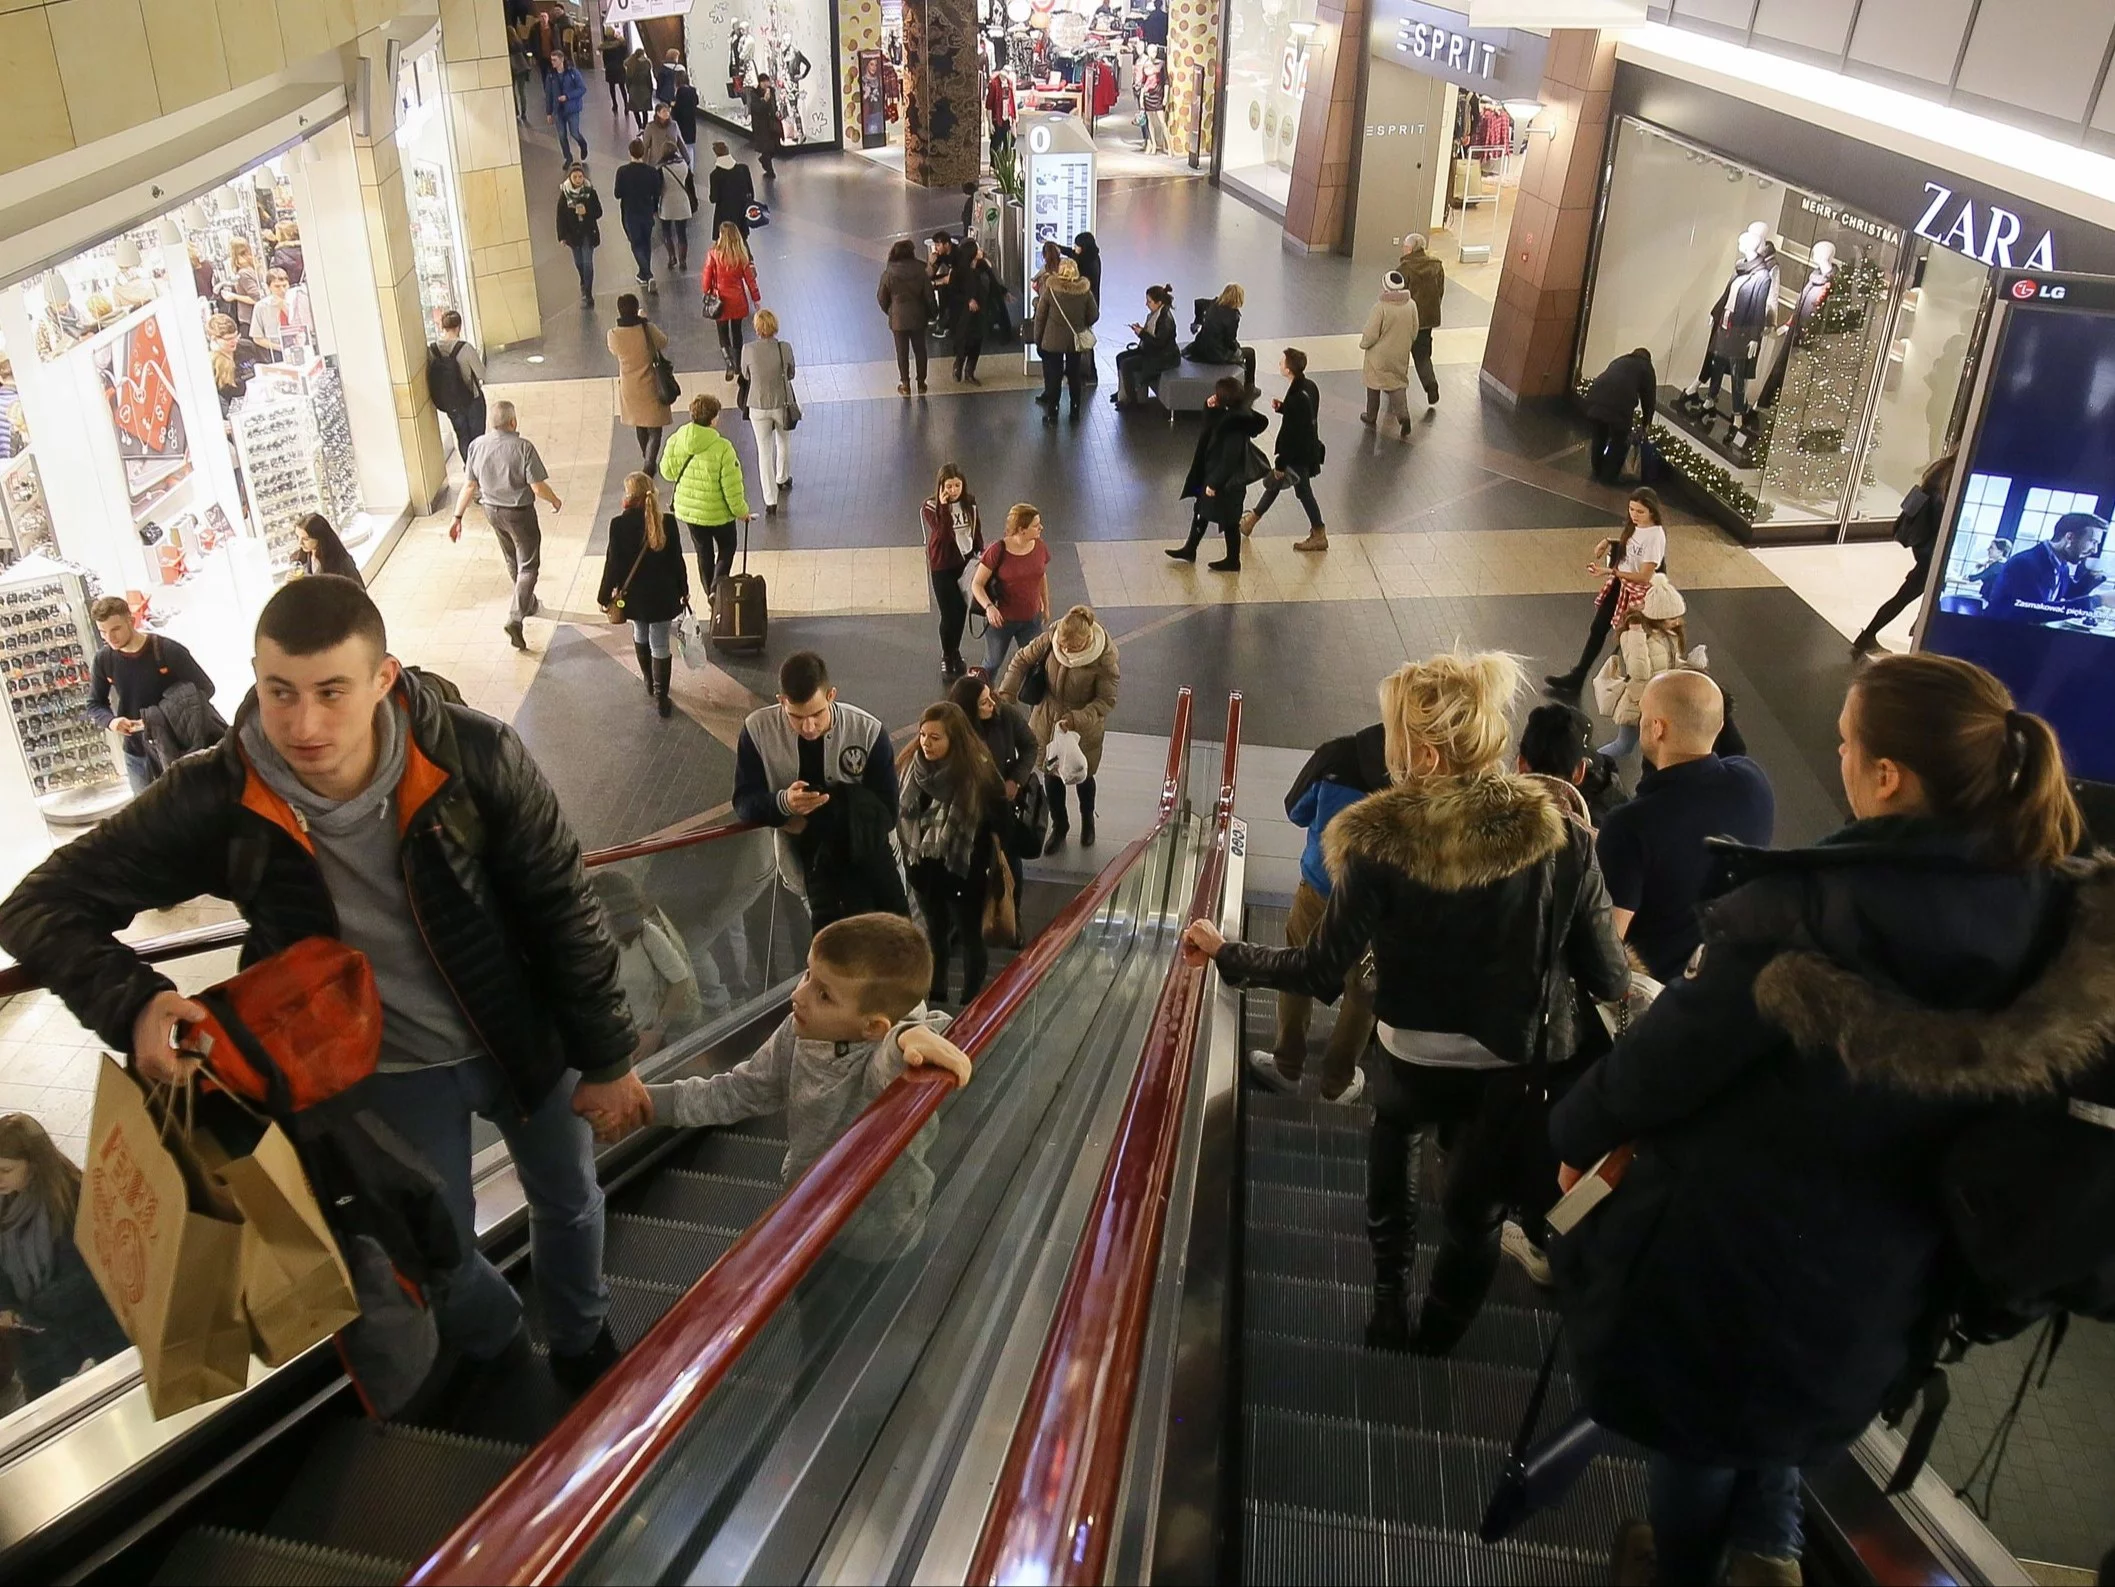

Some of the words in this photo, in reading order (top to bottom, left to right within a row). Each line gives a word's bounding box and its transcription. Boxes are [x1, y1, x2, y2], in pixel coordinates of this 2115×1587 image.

[1396, 18, 1496, 80] ESPRIT
[1366, 124, 1425, 136] ESPRIT
[1801, 197, 1838, 221] MERRY
[1913, 181, 2055, 272] ZARA
[2039, 285, 2066, 300] LG
